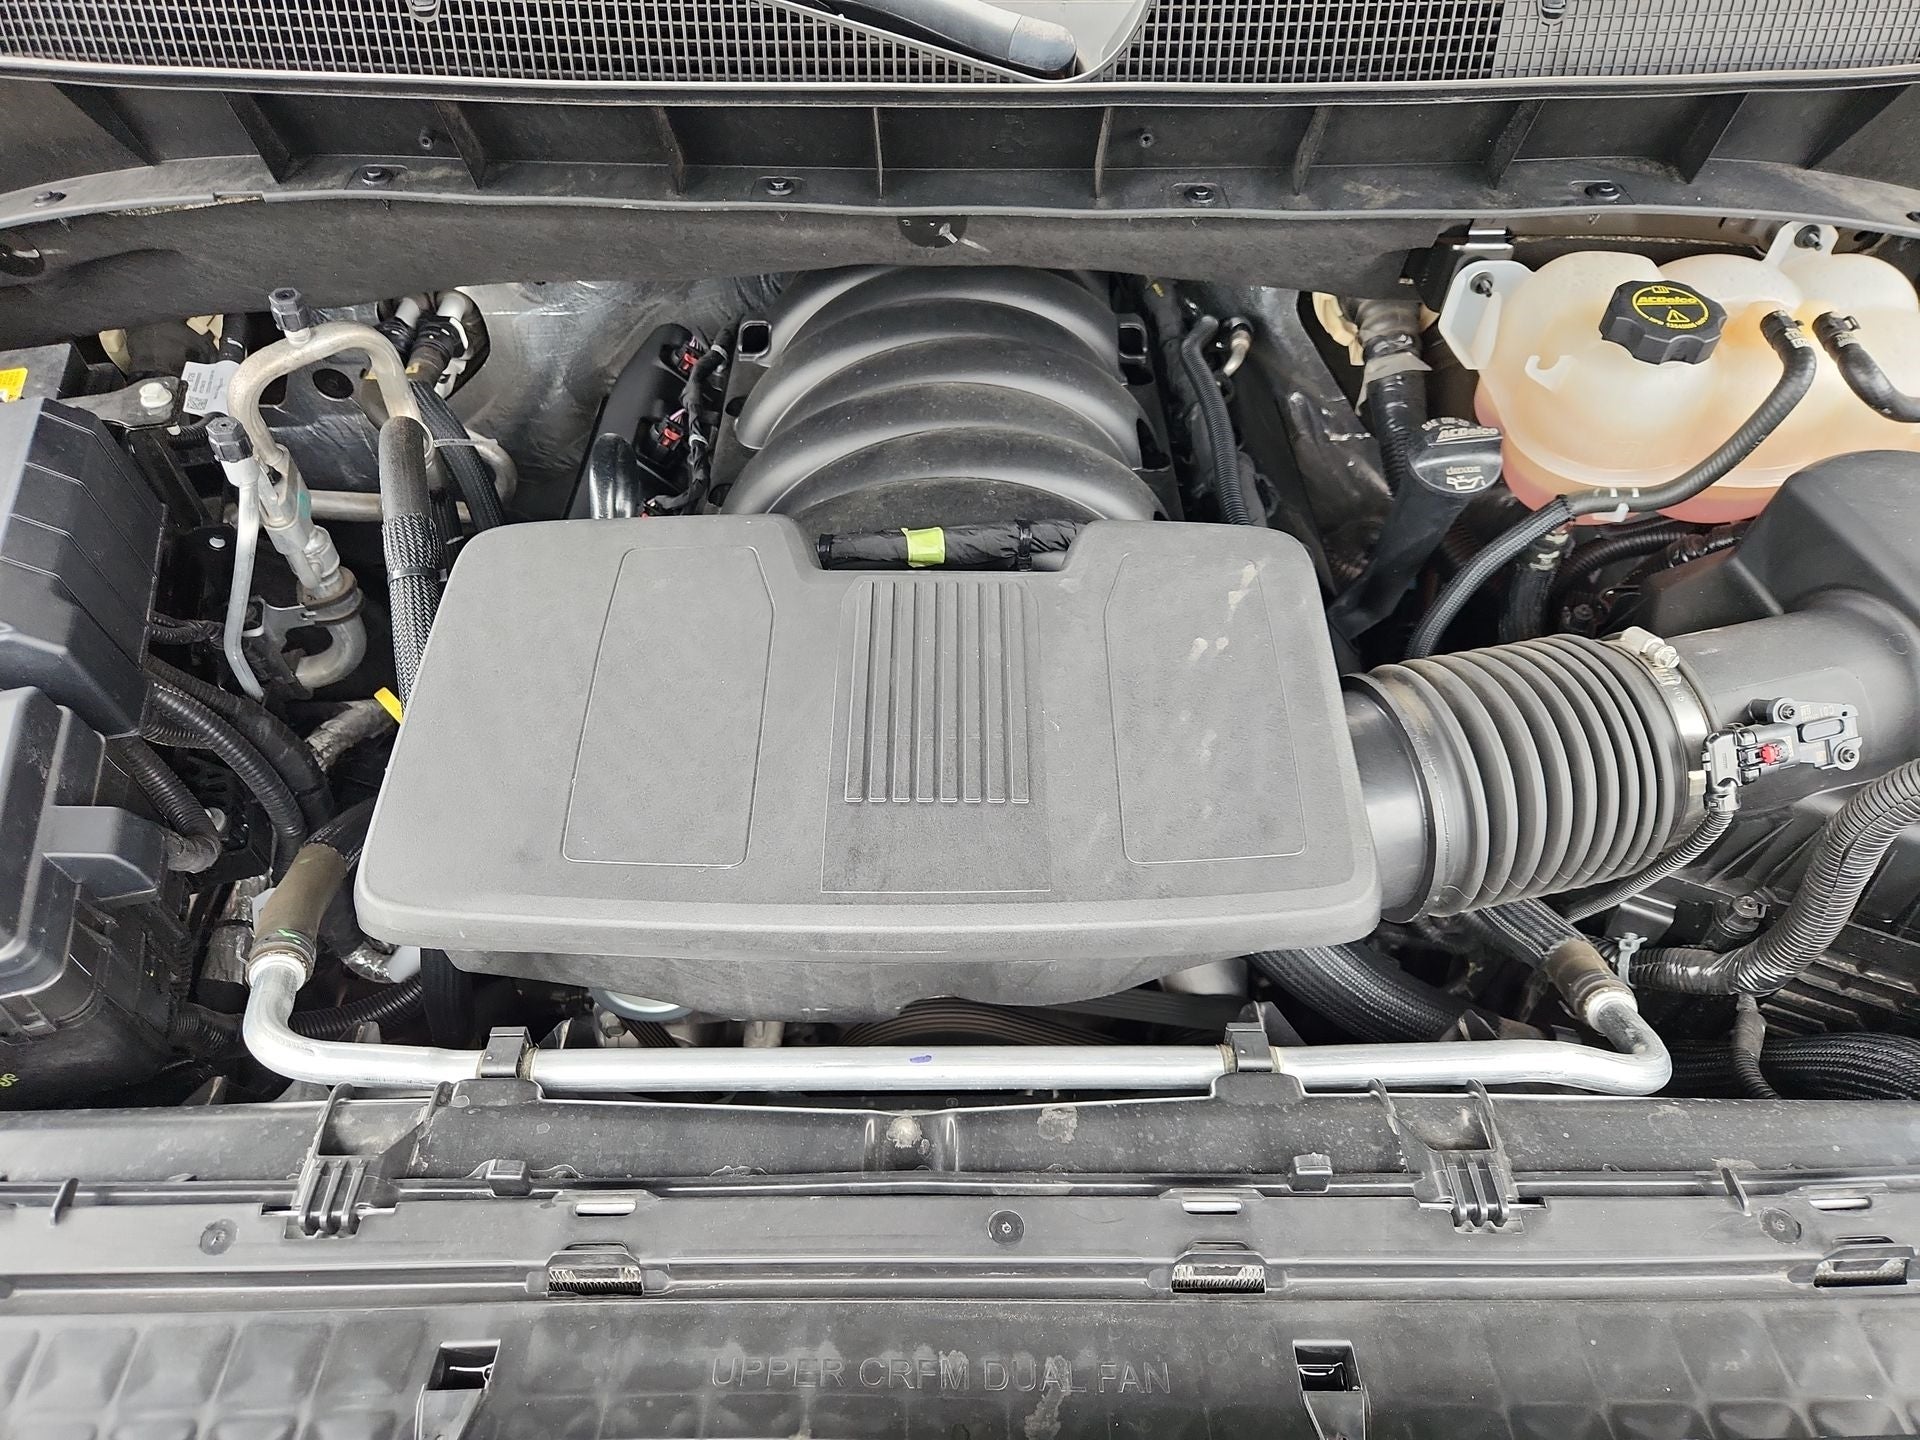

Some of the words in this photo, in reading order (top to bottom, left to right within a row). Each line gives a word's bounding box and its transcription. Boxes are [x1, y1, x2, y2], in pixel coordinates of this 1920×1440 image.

[1637, 297, 1699, 305] ACDelco
[1421, 419, 1440, 431] SAE
[1436, 426, 1499, 442] ACDelco
[712, 1356, 846, 1388] UPPER
[859, 1356, 970, 1391] CRFM
[984, 1358, 1087, 1393] DUAL
[1099, 1360, 1171, 1394] FAN
